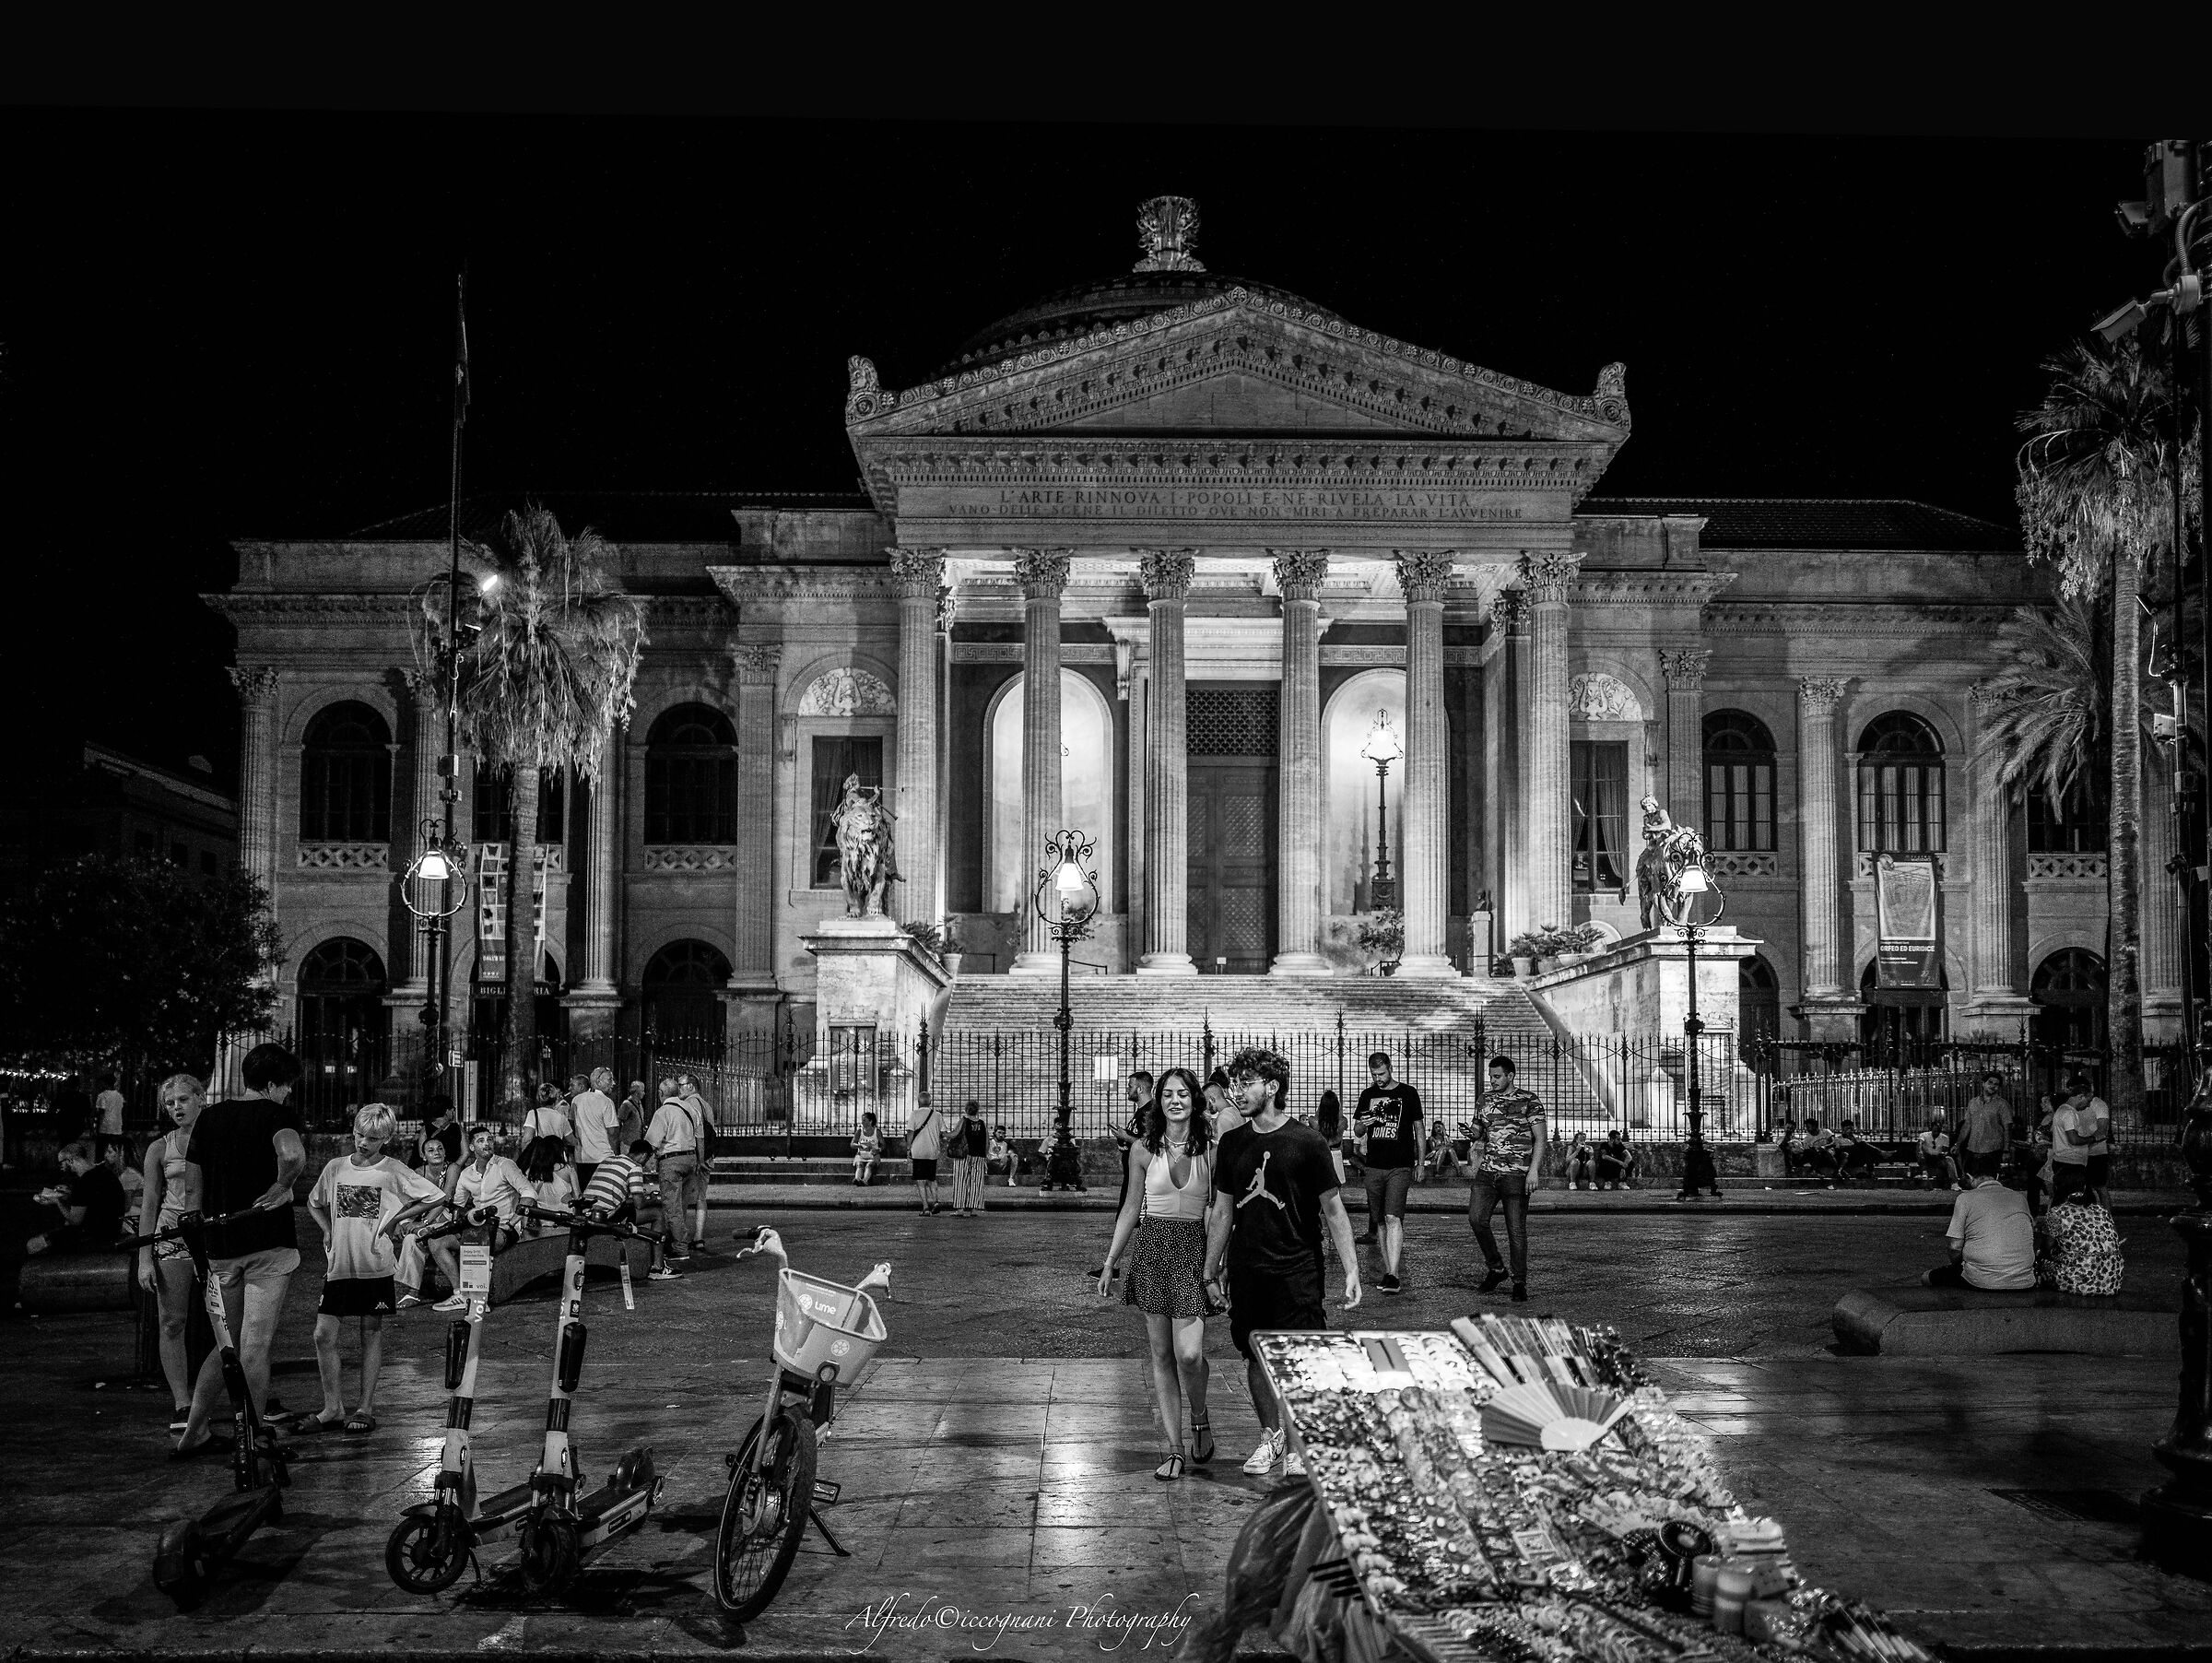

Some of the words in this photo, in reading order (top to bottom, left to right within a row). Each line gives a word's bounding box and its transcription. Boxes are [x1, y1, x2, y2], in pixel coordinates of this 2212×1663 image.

[1001, 490, 1064, 503] L'ARTE
[1076, 490, 1159, 504] RINNOVA
[1187, 491, 1252, 505] POPOLI
[1263, 492, 1272, 505] E
[1283, 492, 1305, 505] NE
[1318, 492, 1383, 506] RIVELA
[1396, 494, 1416, 506] LA
[1427, 494, 1470, 507] VITA
[948, 505, 990, 514] VANO
[999, 505, 1041, 515] DELLE
[1052, 505, 1103, 515] SCENE
[1112, 505, 1127, 515] IL
[1137, 505, 1197, 516] DILETTO
[1209, 506, 1237, 516] OVE
[1248, 507, 1279, 516] NON
[1293, 507, 1326, 517] MIRI
[1336, 507, 1344, 517] A
[1353, 507, 1428, 518] PREPARAR
[1439, 508, 1522, 518] L'AVVENIRE
[1372, 1126, 1397, 1138] JONES
